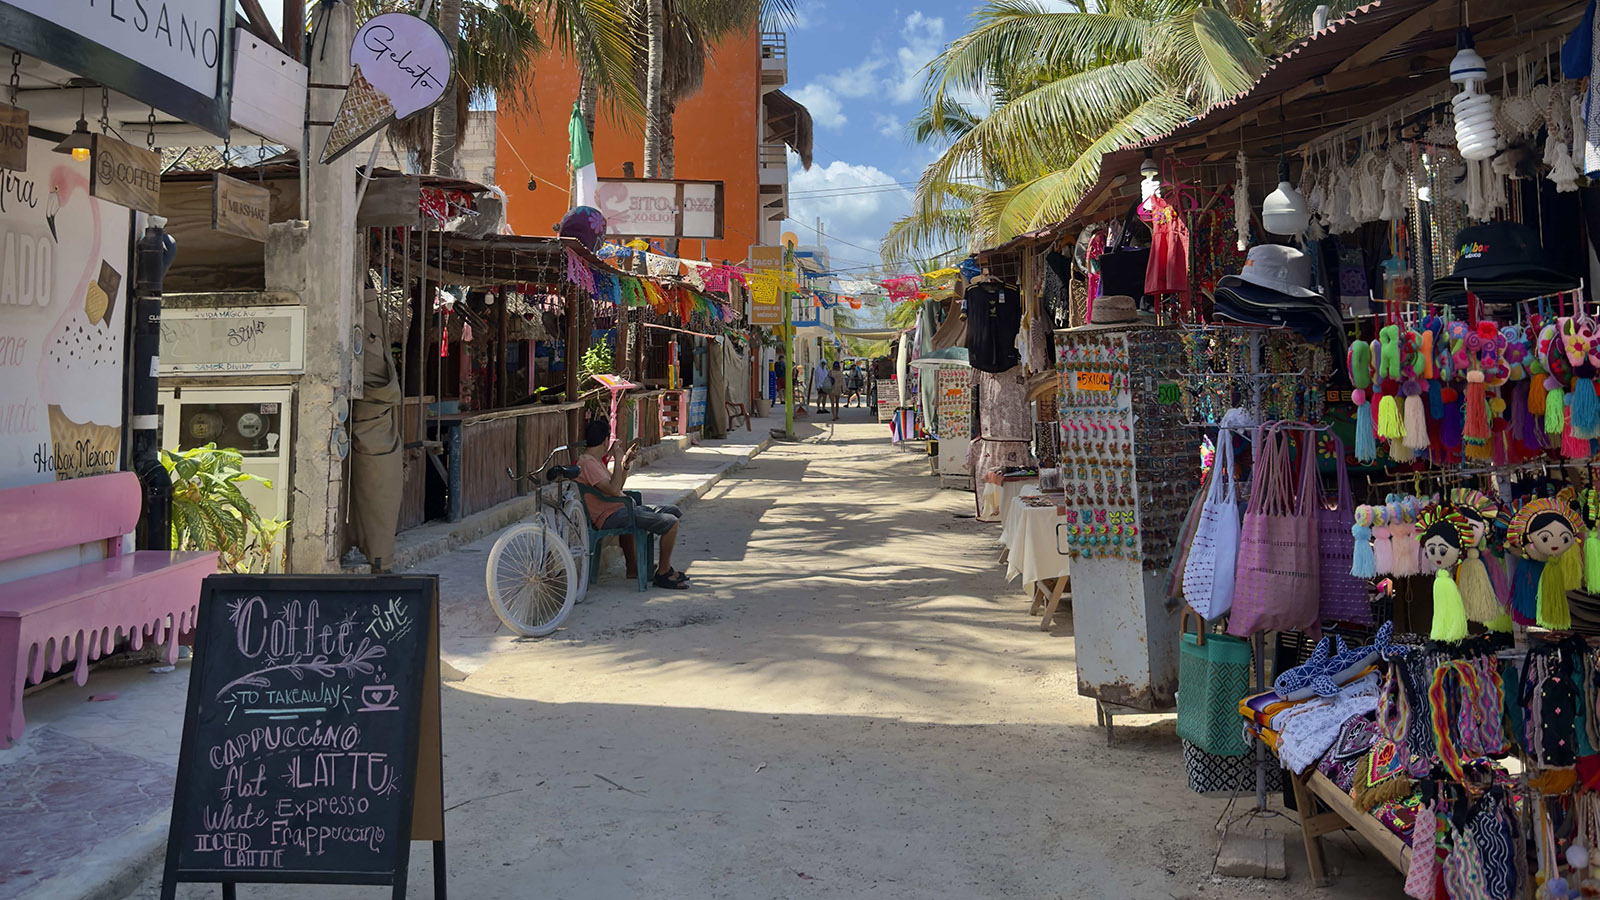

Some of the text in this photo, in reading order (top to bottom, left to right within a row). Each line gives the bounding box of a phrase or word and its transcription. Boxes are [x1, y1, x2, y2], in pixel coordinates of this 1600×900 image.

[363, 25, 443, 89] Gelato
[117, 162, 159, 193] COFFEE
[228, 199, 267, 221] MILKSHAKE
[1460, 241, 1490, 256] Holbox
[33, 438, 115, 473] Holbox, México
[236, 595, 354, 658] Coffee
[236, 682, 341, 708] TO TAKEAWAY
[291, 752, 389, 796] LATTE
[203, 799, 269, 831] White
[277, 795, 369, 821] Expresso
[193, 832, 252, 852] ICED
[270, 820, 385, 856] Frappuccino
[224, 850, 285, 868] LATTE
